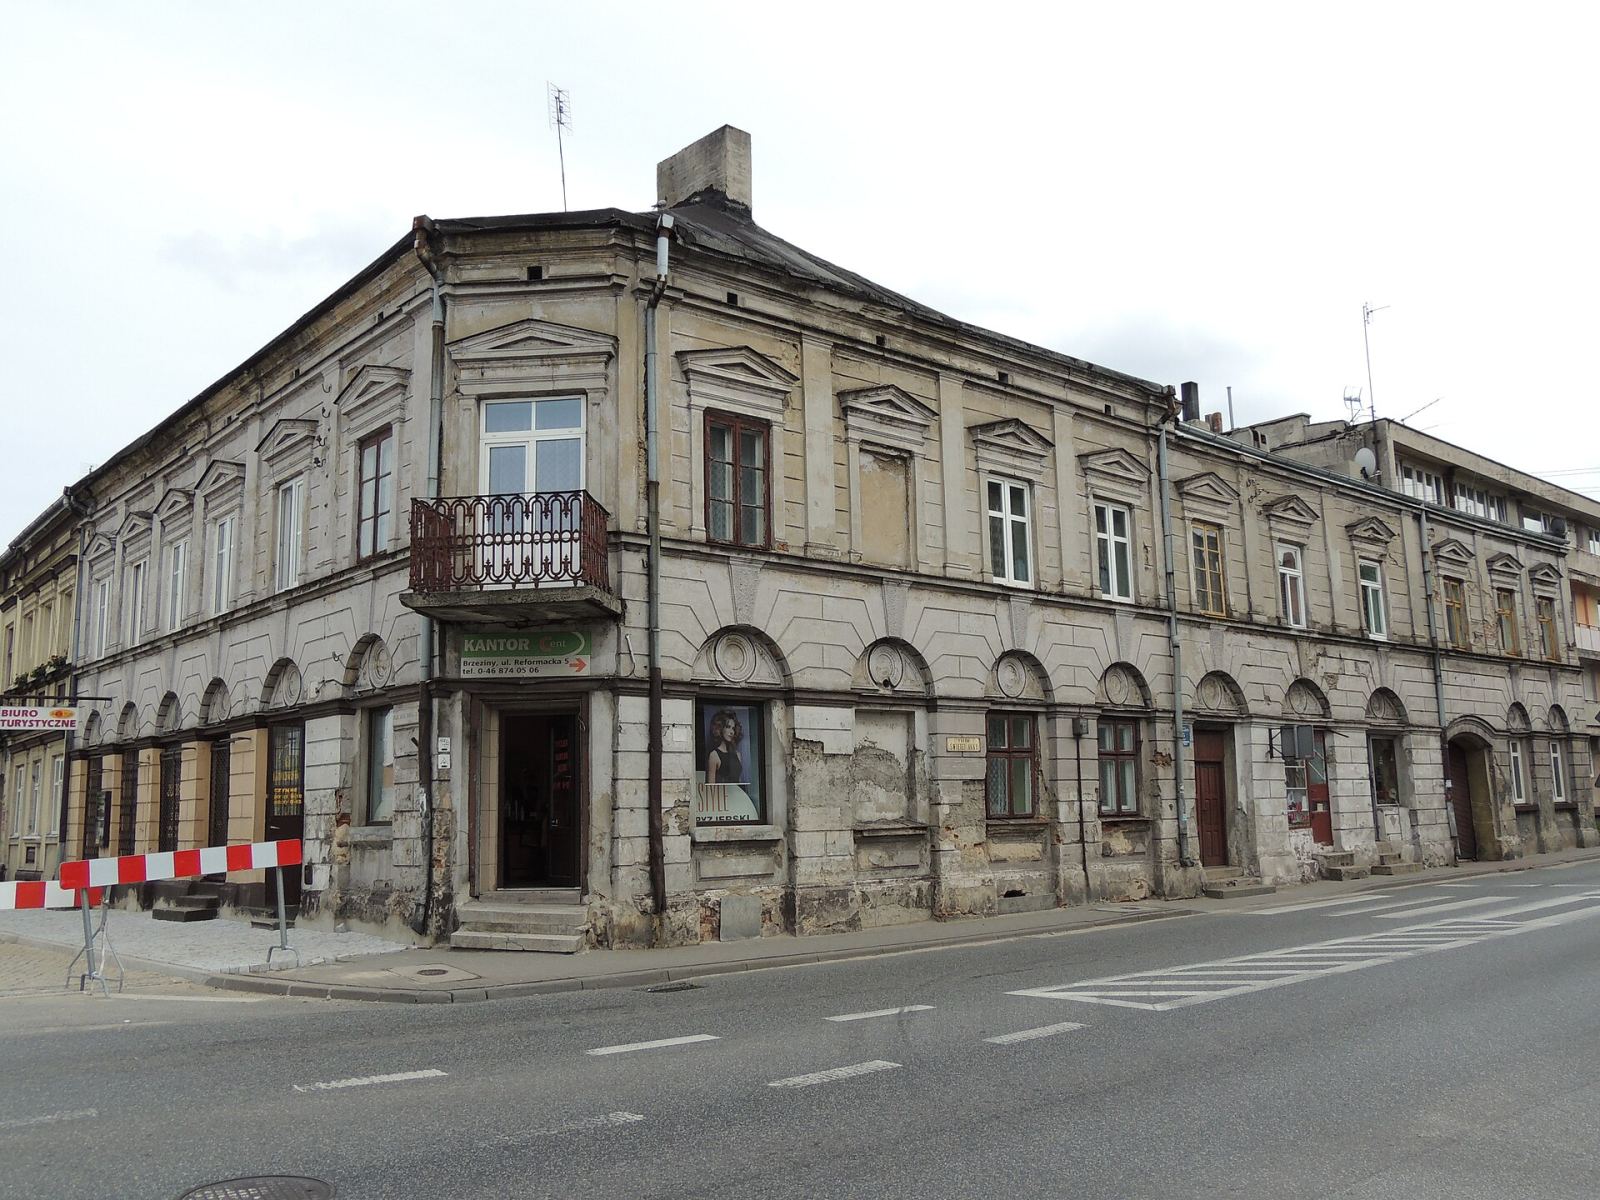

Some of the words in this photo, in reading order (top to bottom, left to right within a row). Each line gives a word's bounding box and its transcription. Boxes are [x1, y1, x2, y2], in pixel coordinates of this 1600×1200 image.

[464, 639, 530, 652] KANTOR
[463, 660, 499, 668] Brzeziny,
[514, 658, 562, 666] Reformacka
[498, 666, 514, 674] 874
[516, 666, 527, 674] 05
[529, 666, 540, 674] 06
[1, 709, 38, 717] BIURO
[0, 719, 76, 728] TURYSTYCZNE
